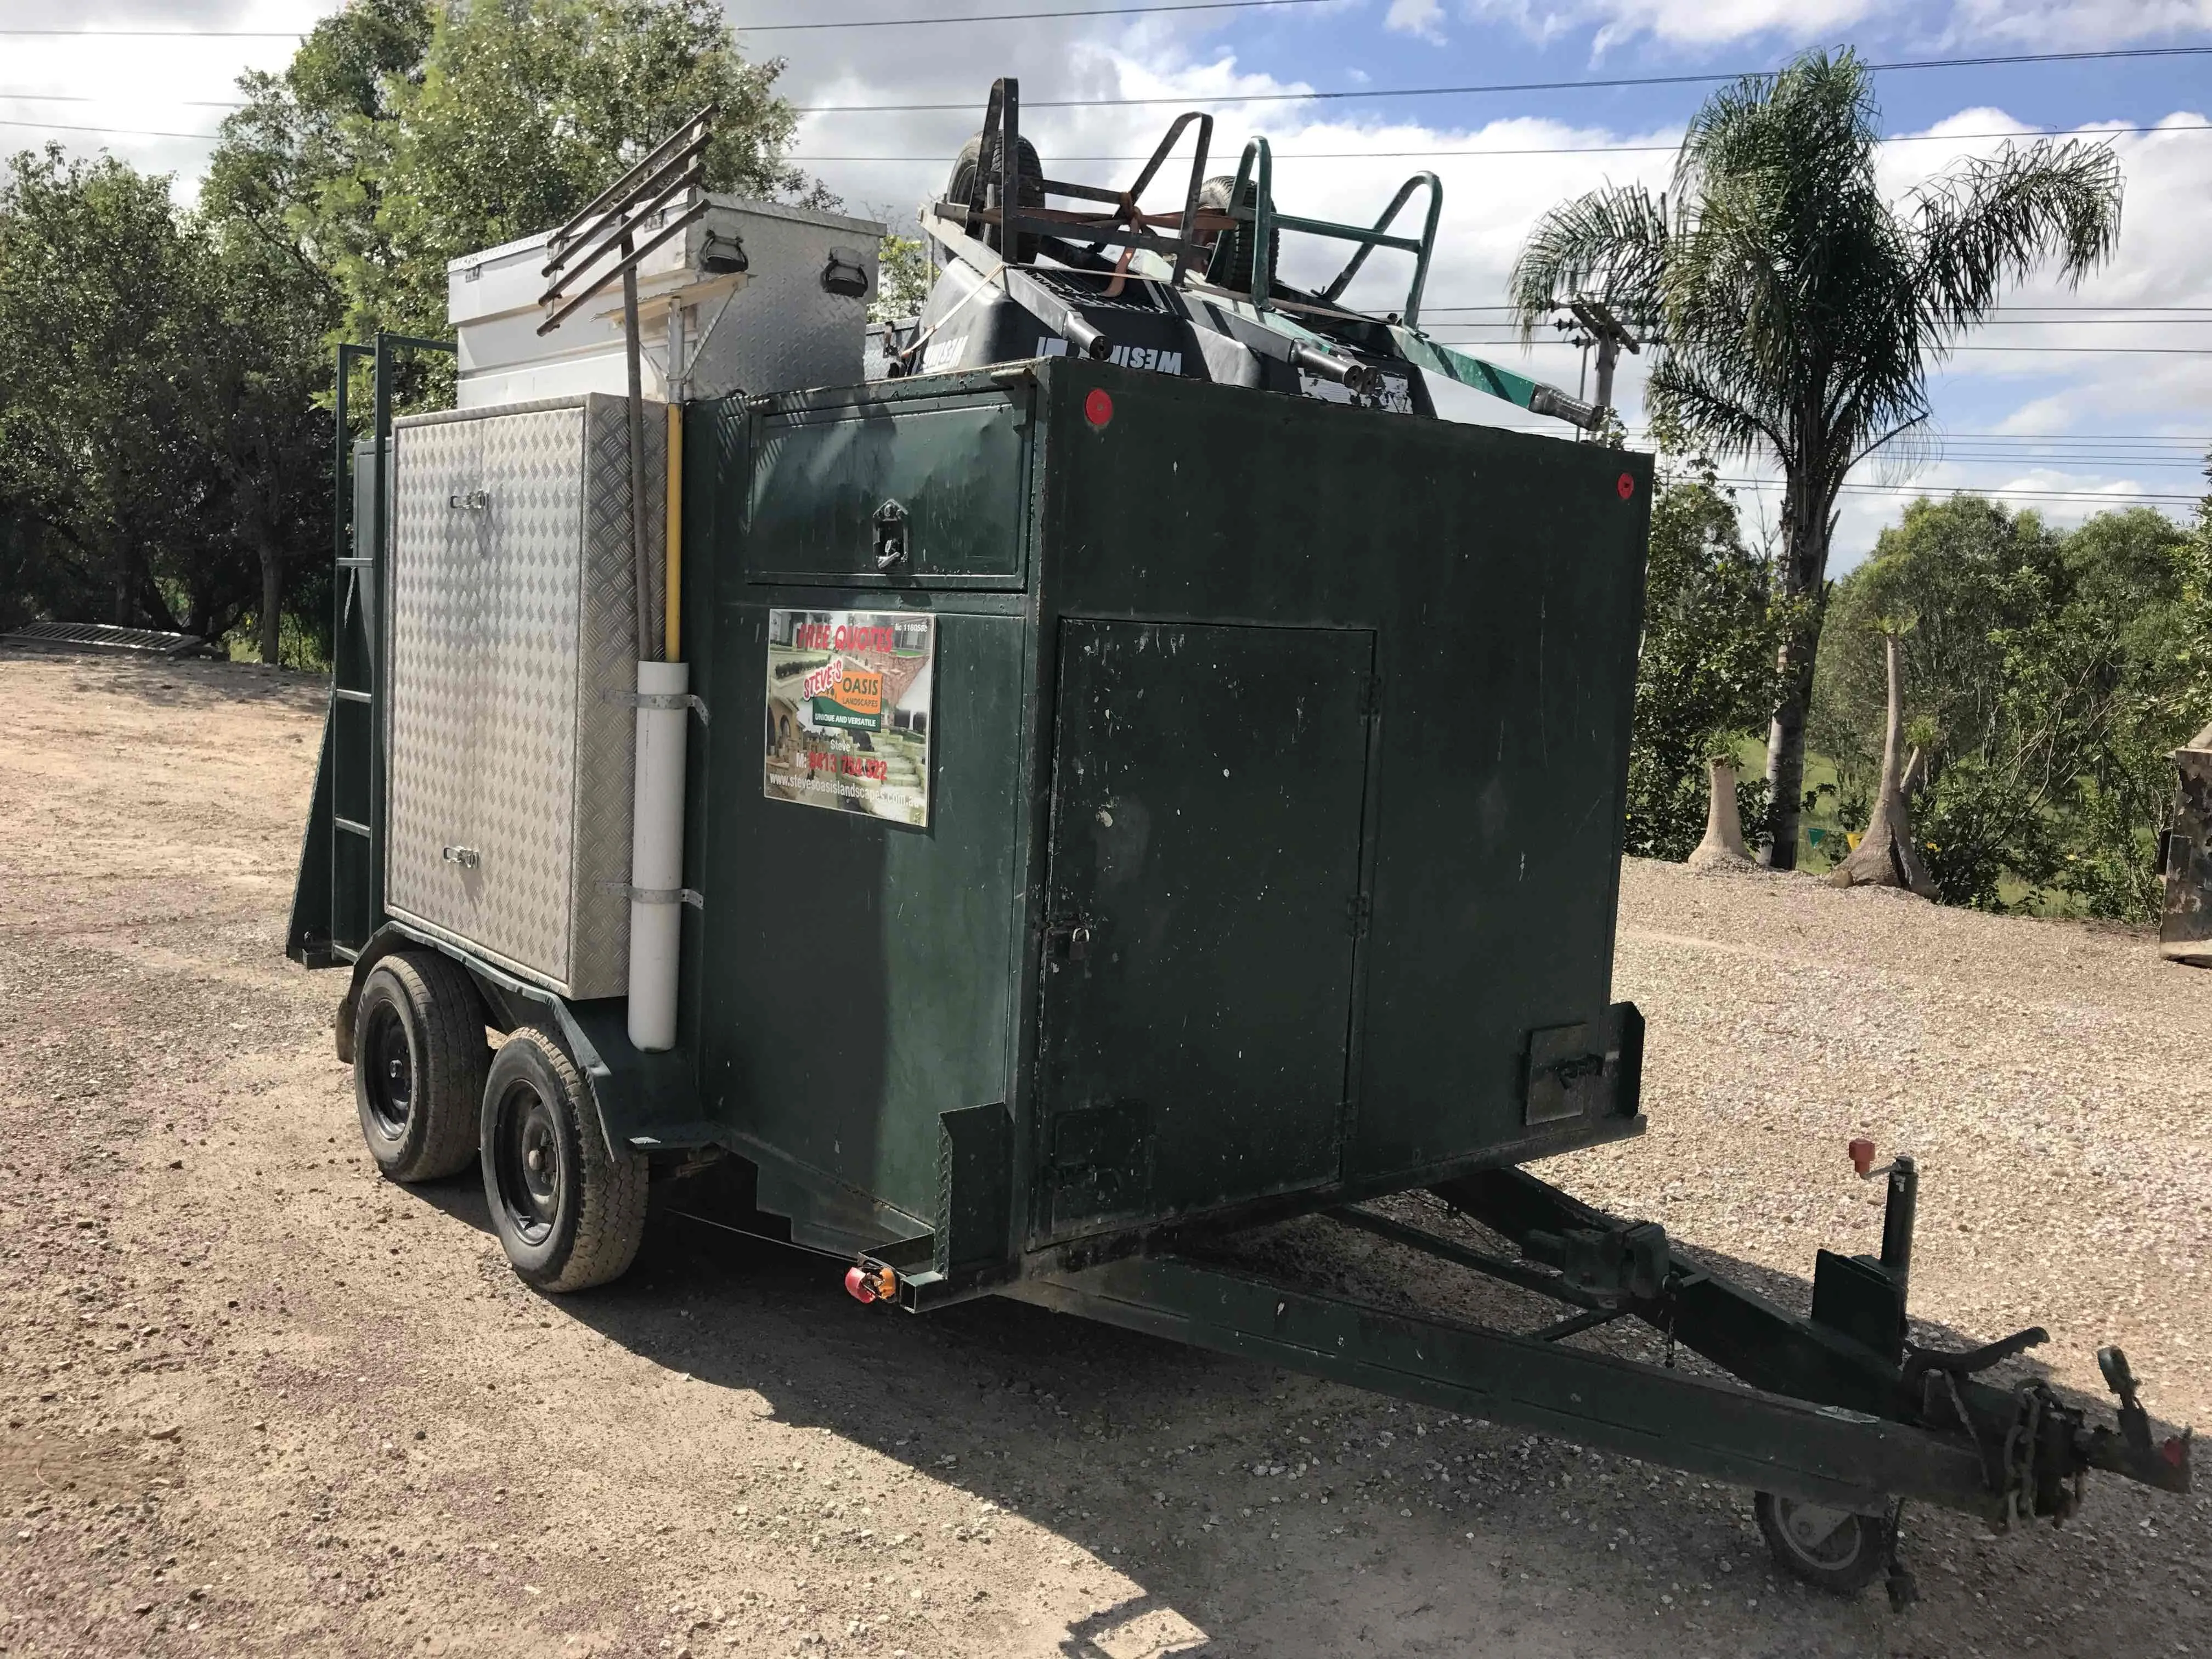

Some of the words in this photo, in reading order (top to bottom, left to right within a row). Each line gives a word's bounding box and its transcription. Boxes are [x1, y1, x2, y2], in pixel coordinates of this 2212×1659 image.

[797, 623, 831, 650] FREE
[834, 625, 894, 652] QUOTES
[803, 659, 842, 700] STEVE'S
[843, 678, 878, 696] OASIS
[842, 697, 878, 708] LANDSCAPES
[815, 713, 835, 723] UNIQUE
[835, 715, 848, 724] AND
[848, 716, 876, 727] VERSATILE
[830, 739, 851, 752] Steve
[795, 752, 807, 769] M:
